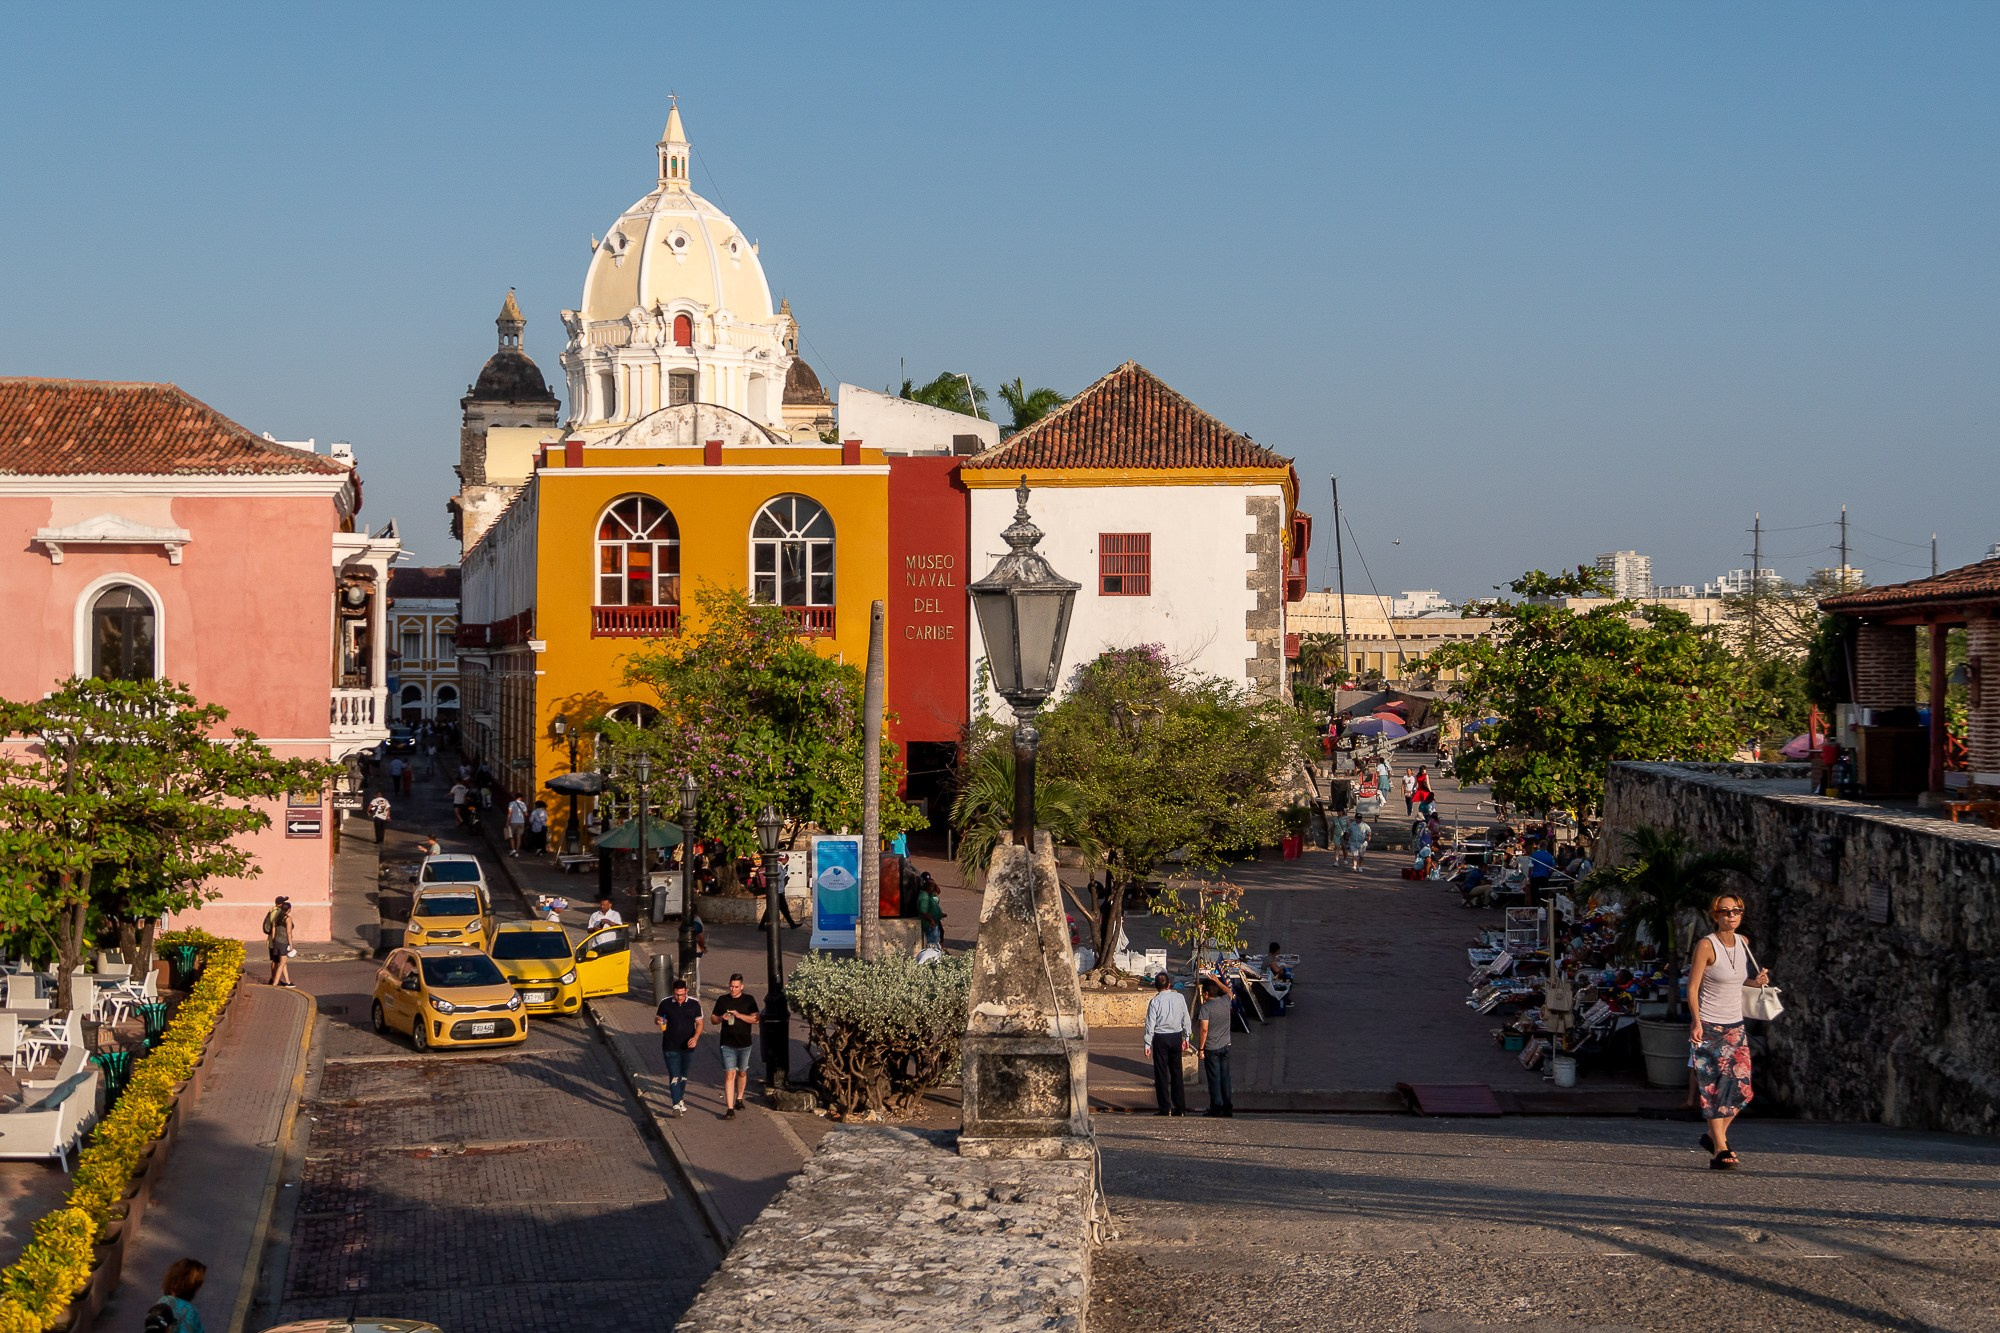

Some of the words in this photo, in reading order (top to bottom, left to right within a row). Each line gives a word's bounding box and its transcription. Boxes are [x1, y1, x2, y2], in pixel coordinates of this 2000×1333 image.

[906, 554, 954, 569] MUSEO
[906, 572, 955, 587] NAVAL
[914, 598, 944, 613] DEL
[905, 625, 954, 640] CARIBE
